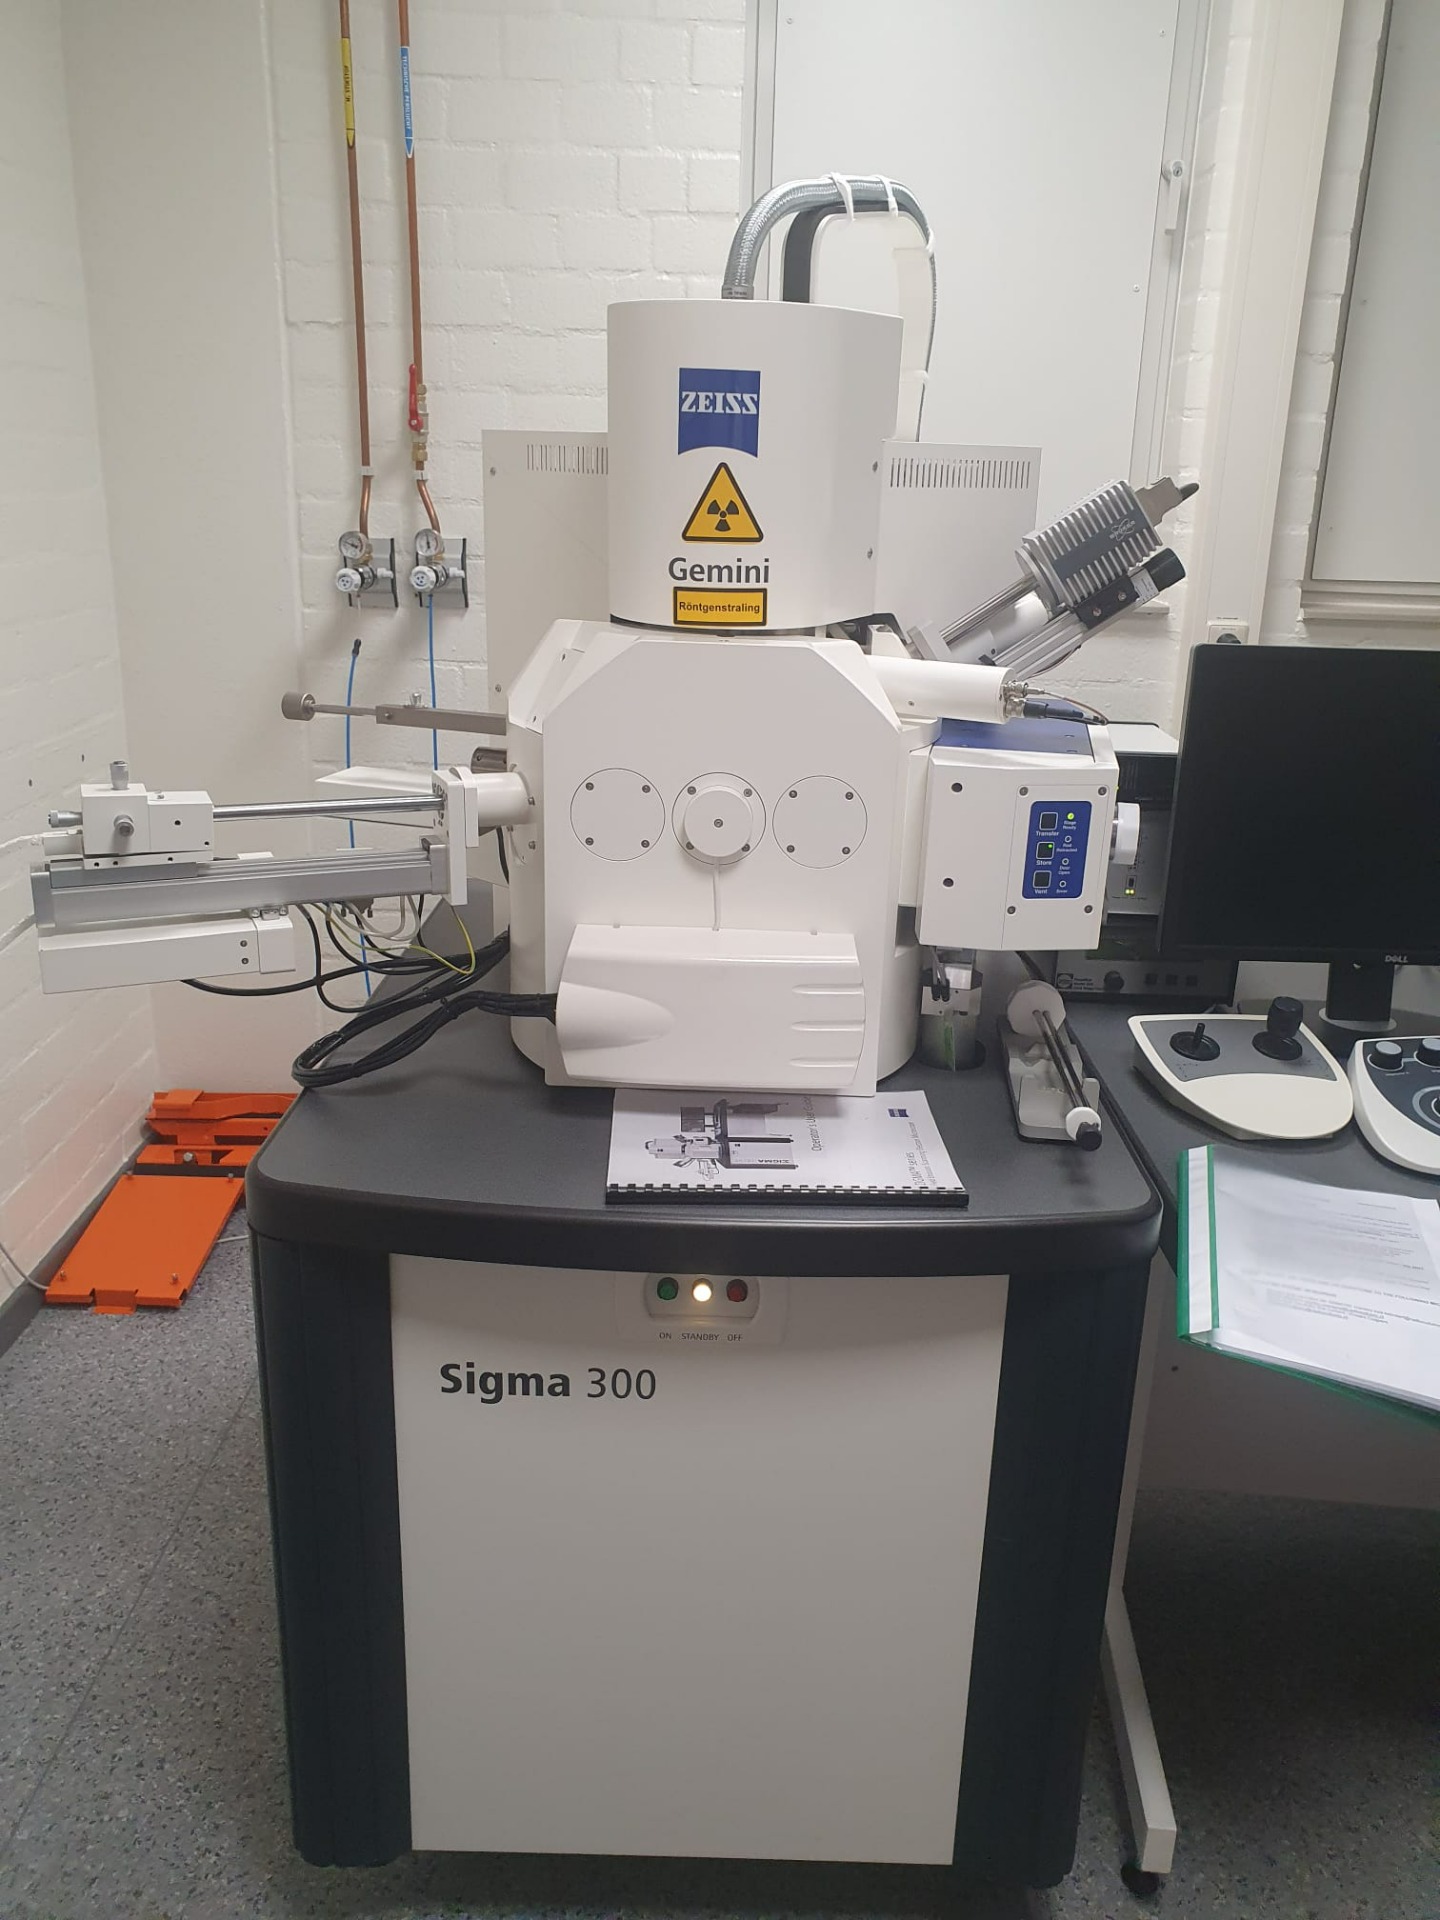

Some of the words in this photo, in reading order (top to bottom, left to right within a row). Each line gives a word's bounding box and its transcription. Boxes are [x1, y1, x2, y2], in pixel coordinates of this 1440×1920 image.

[681, 390, 758, 415] ZEISS
[667, 556, 770, 584] Gemini
[679, 600, 760, 614] Röntgenstraling
[1384, 954, 1409, 963] DELL
[658, 1332, 672, 1340] ON
[681, 1332, 720, 1342] STANDBY
[727, 1333, 744, 1343] OFF
[440, 1361, 571, 1405] Sigma
[586, 1367, 657, 1400] 300
